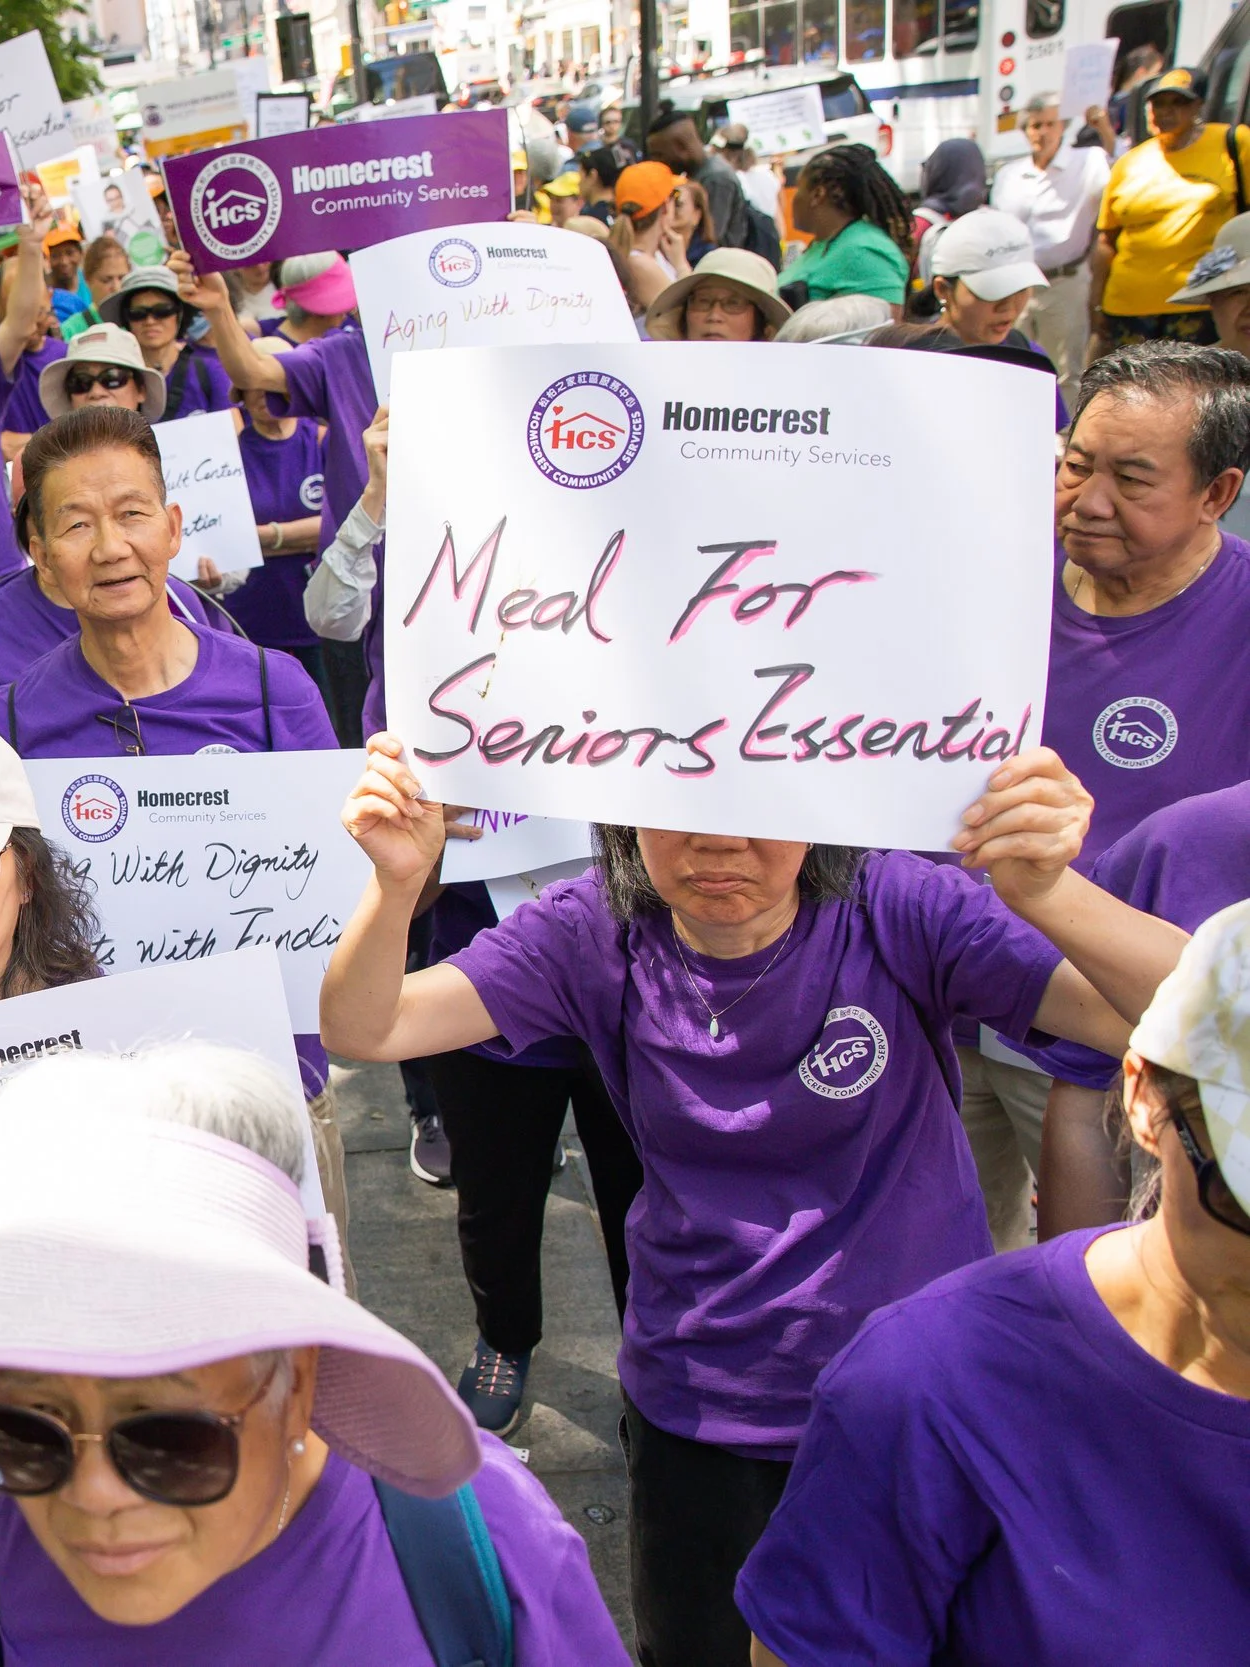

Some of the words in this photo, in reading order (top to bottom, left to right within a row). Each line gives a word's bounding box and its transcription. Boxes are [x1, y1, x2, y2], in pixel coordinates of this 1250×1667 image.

[292, 151, 434, 195] Homecrest
[208, 201, 261, 229] HCS
[311, 189, 412, 216] Community
[417, 182, 489, 202] Services
[486, 246, 548, 259] Homecrest
[383, 309, 448, 351] Aging
[460, 292, 514, 322] With
[526, 287, 593, 328] Dignity
[551, 419, 616, 450] HCS
[661, 401, 831, 435] Homecrest
[529, 411, 554, 474] HOMECREST
[552, 461, 623, 487] COMMUNITY
[622, 411, 642, 464] SERVICES
[680, 441, 801, 467] Community
[807, 445, 893, 468] Services
[403, 514, 626, 643] Meal
[667, 539, 882, 645] For
[413, 652, 729, 779] Seniors
[739, 663, 1032, 762] Essential
[76, 803, 113, 820] HCS
[137, 789, 229, 808] Homecrest
[79, 826, 119, 842] COMMUNITY
[149, 812, 215, 825] Community
[219, 810, 267, 822] Services
[111, 846, 189, 888] With
[205, 842, 318, 901] Dignity
[800, 1060, 831, 1095] OMECREST
[834, 1062, 882, 1097] COMMUNITY
[867, 1020, 885, 1060] SERVICES
[814, 1041, 868, 1077] HCS
